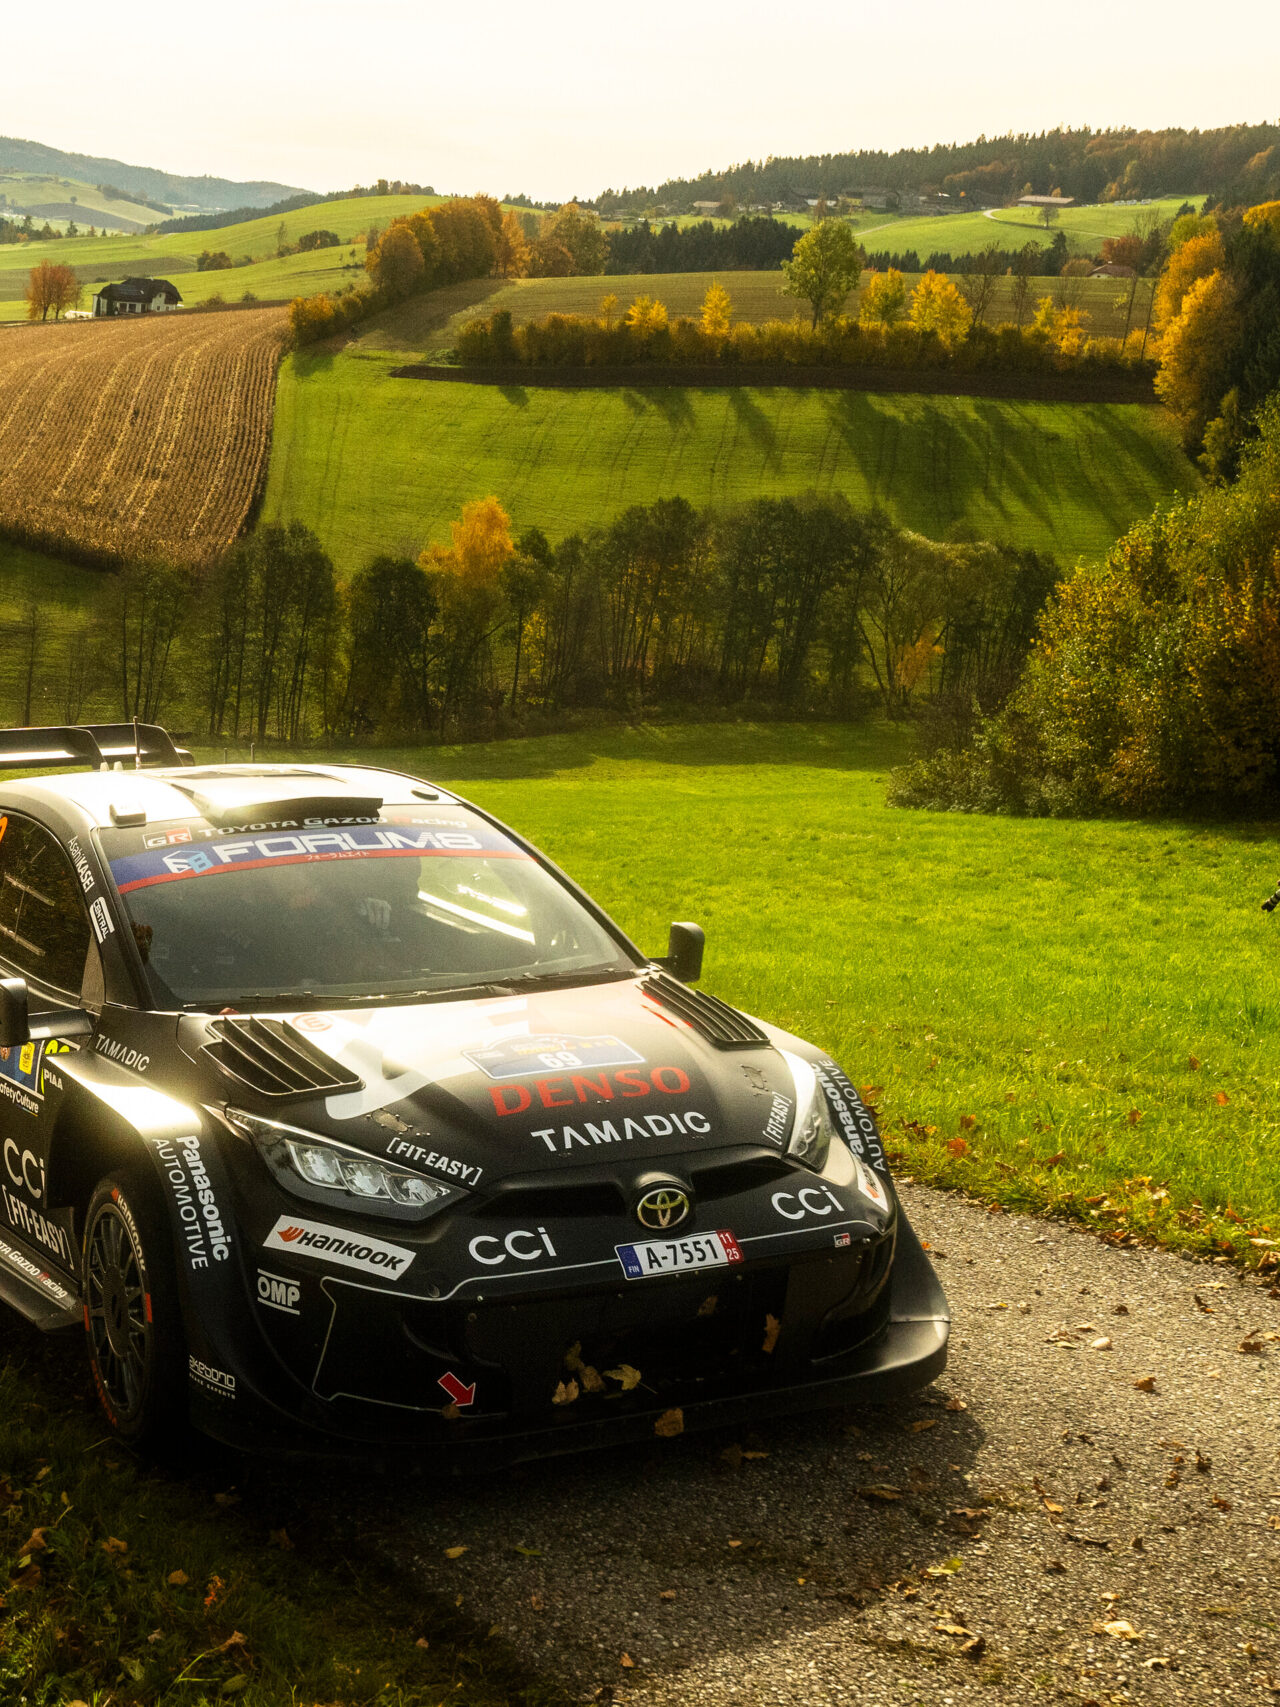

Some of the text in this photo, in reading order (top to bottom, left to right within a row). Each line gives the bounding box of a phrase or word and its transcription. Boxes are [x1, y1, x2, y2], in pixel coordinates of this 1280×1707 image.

[147, 816, 467, 848] GR TOYOTA GAZOO Racing
[212, 832, 482, 863] FORUM8
[68, 835, 95, 893] AsahiKASEI
[93, 899, 109, 939] CENTRAL
[95, 1033, 150, 1071] TAMADIC
[538, 1051, 583, 1069] 69
[43, 1067, 63, 1091] PIAA
[488, 1066, 690, 1117] DENSO
[530, 1111, 711, 1152] TAMADIC
[818, 1059, 887, 1172] AUTOMOTIVE
[386, 1137, 483, 1186] [FIT-EASY]
[151, 1138, 209, 1270] AUTOMOTIVE
[176, 1135, 232, 1261] Panasonic
[645, 1238, 718, 1269] A-7551
[719, 1233, 733, 1244] 11
[726, 1248, 740, 1261] 25
[8, 1250, 41, 1276] GAZOO
[37, 1272, 68, 1299] Racing
[628, 1265, 640, 1273] FIN
[257, 1276, 300, 1307] OMP
